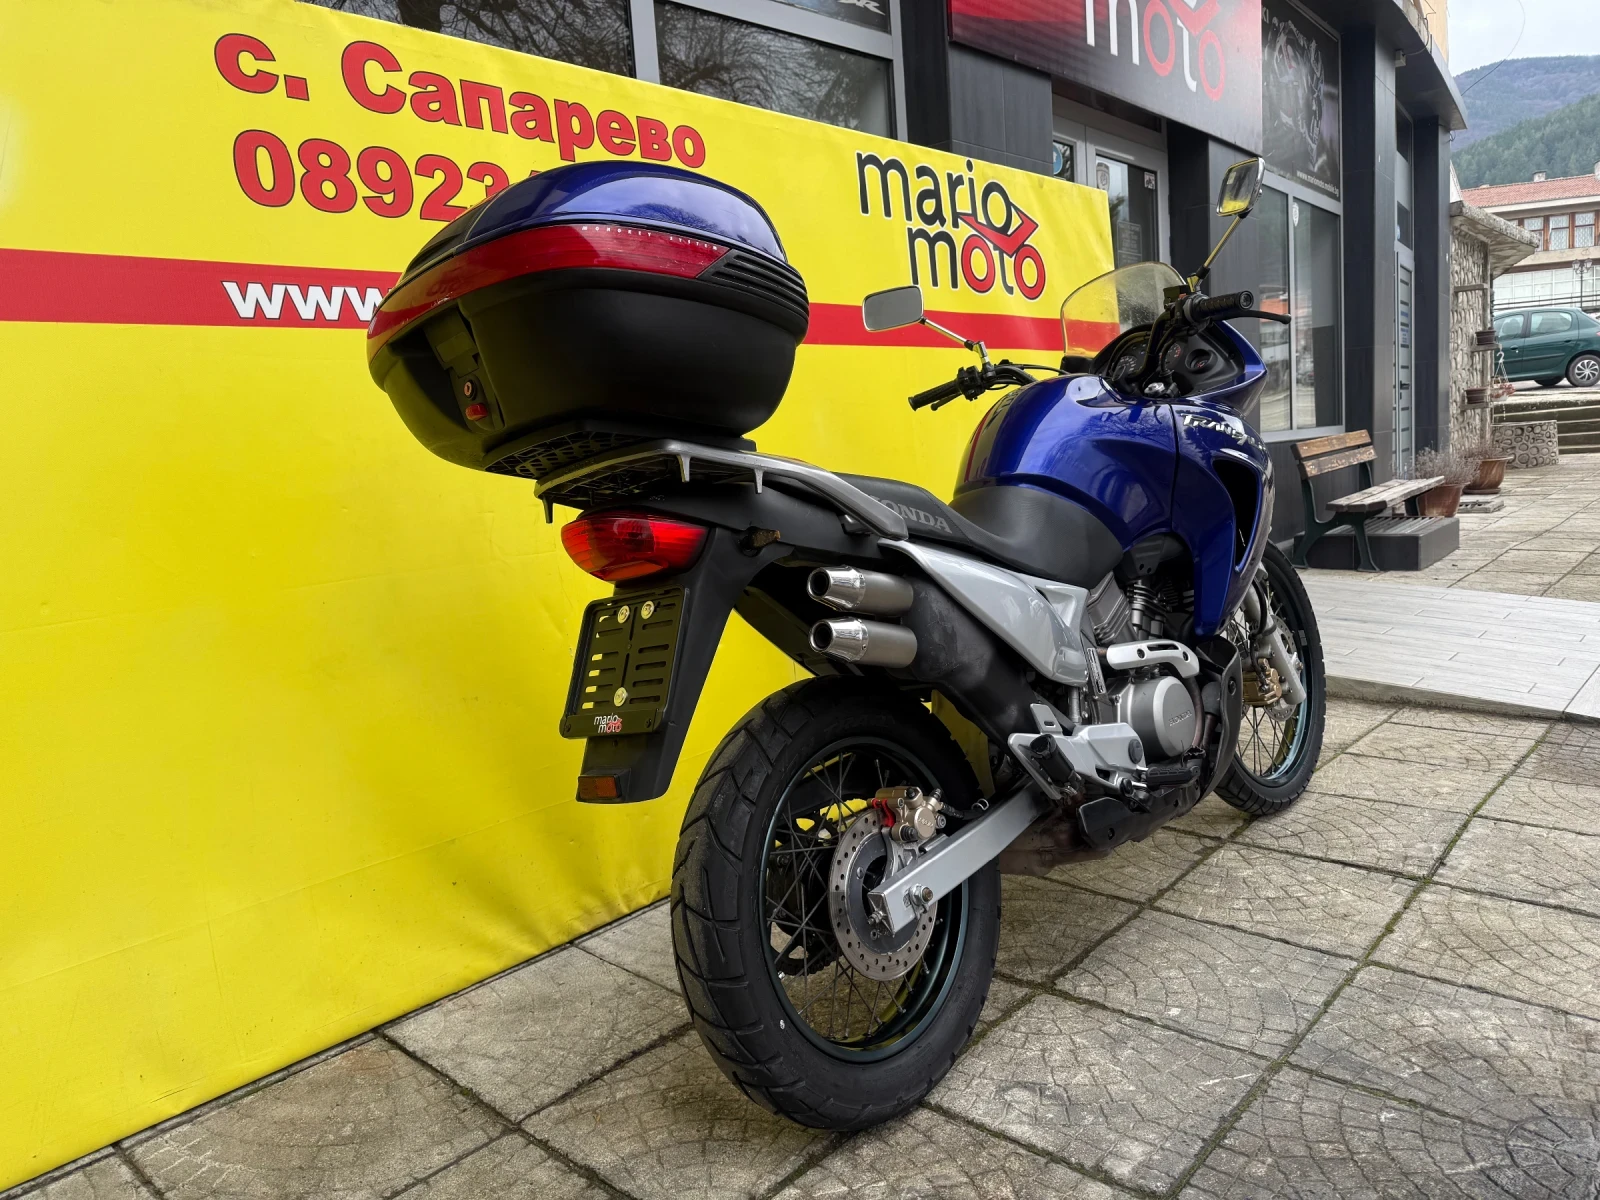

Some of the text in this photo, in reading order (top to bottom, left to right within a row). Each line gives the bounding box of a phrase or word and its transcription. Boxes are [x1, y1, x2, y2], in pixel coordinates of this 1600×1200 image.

[1084, 0, 1227, 101] moto
[213, 33, 706, 168] с. Сапарево
[232, 129, 543, 222] 08923
[856, 152, 1012, 234] mario
[581, 226, 718, 251] MONOKEY SYSTEM
[907, 227, 1046, 300] moto
[870, 495, 953, 534] ONDA
[593, 712, 618, 726] mario
[597, 722, 622, 733] moto
